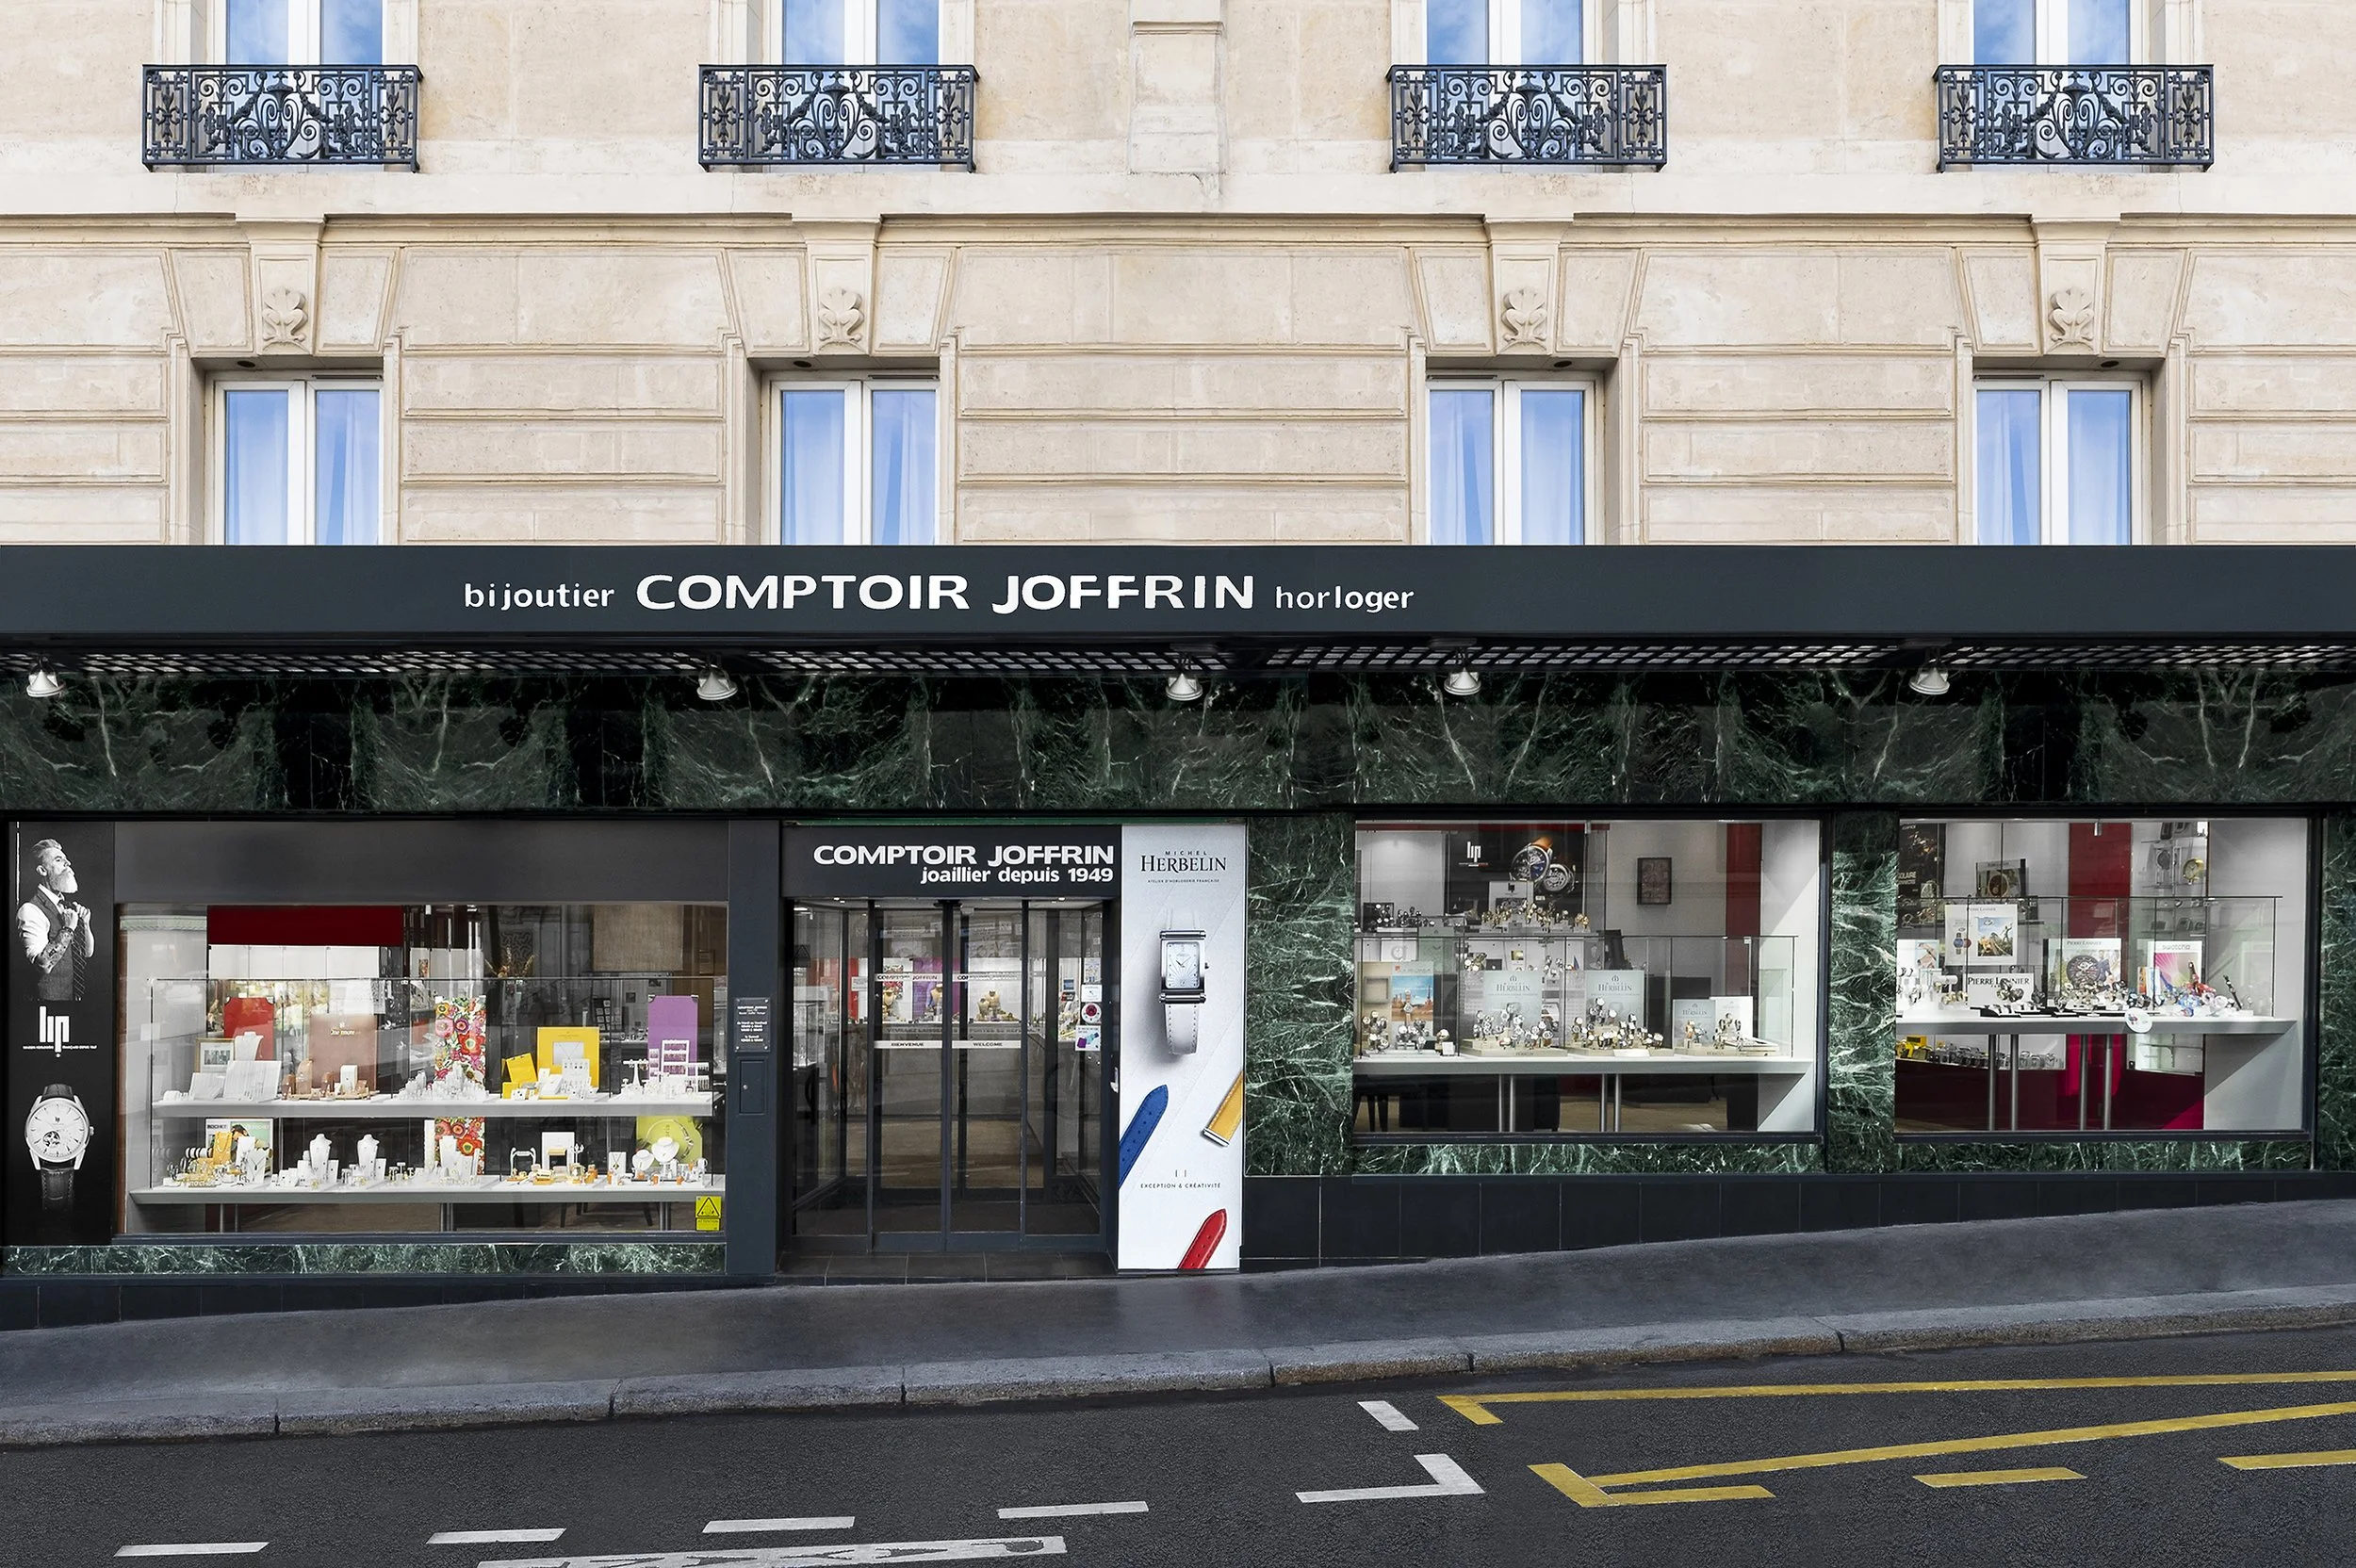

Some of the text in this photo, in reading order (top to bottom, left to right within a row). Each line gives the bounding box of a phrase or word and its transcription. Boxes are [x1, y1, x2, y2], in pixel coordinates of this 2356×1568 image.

[465, 574, 1415, 614] bijoutier COMPTOIR JOFFRIN horloger
[813, 845, 1114, 867] COMPTOIR JOFFRIN
[1140, 855, 1227, 874] HERBELIN
[920, 866, 1114, 884] joaillier depuis 1949
[1968, 976, 2030, 986] PIERRE LNIER
